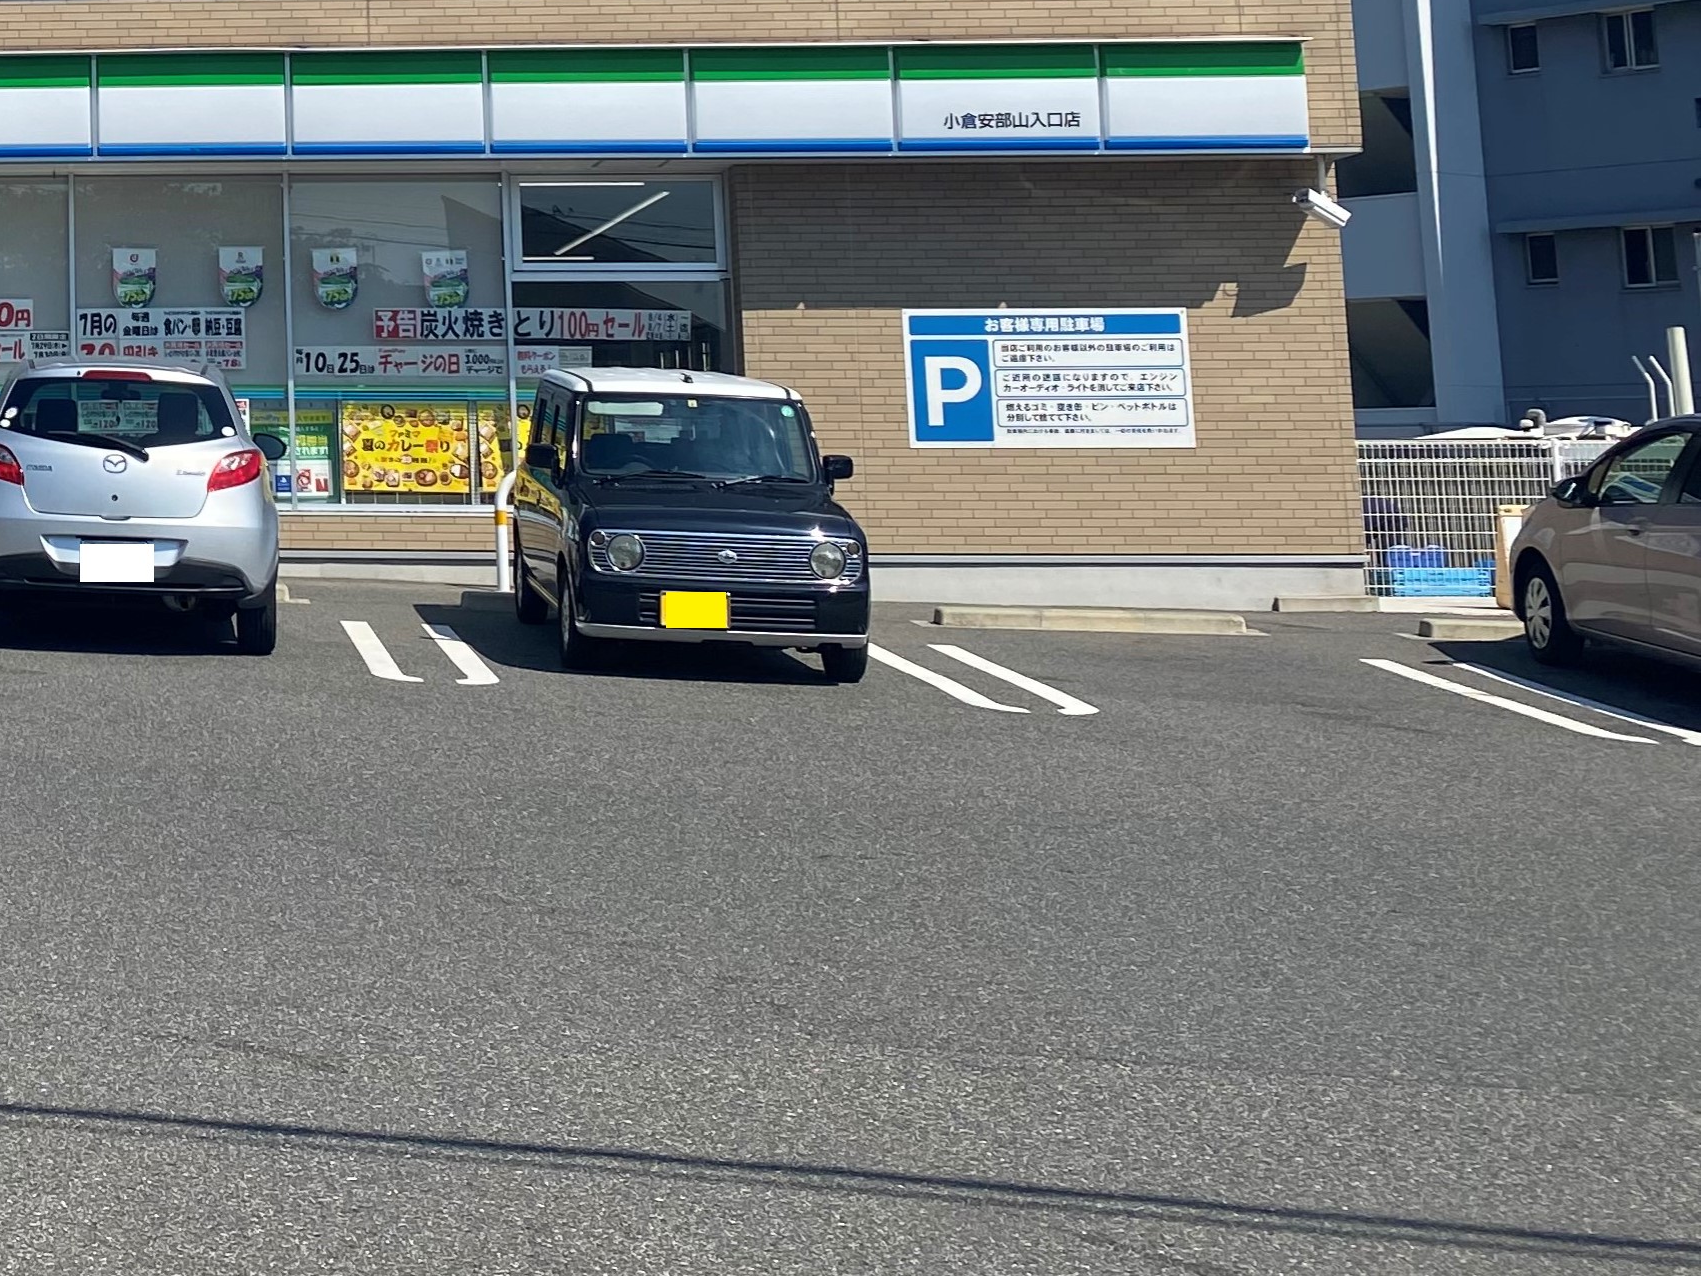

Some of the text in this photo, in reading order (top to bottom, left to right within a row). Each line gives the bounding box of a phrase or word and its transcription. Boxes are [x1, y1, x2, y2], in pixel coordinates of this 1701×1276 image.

[944, 112, 1081, 129] 小倉安部山入口店
[79, 312, 117, 336] 7月の
[123, 325, 158, 336] 金曜日は
[376, 311, 416, 338] 予告
[984, 316, 1105, 333] お客様専用駐車場
[378, 354, 460, 374] チャージの日
[924, 356, 982, 426] P
